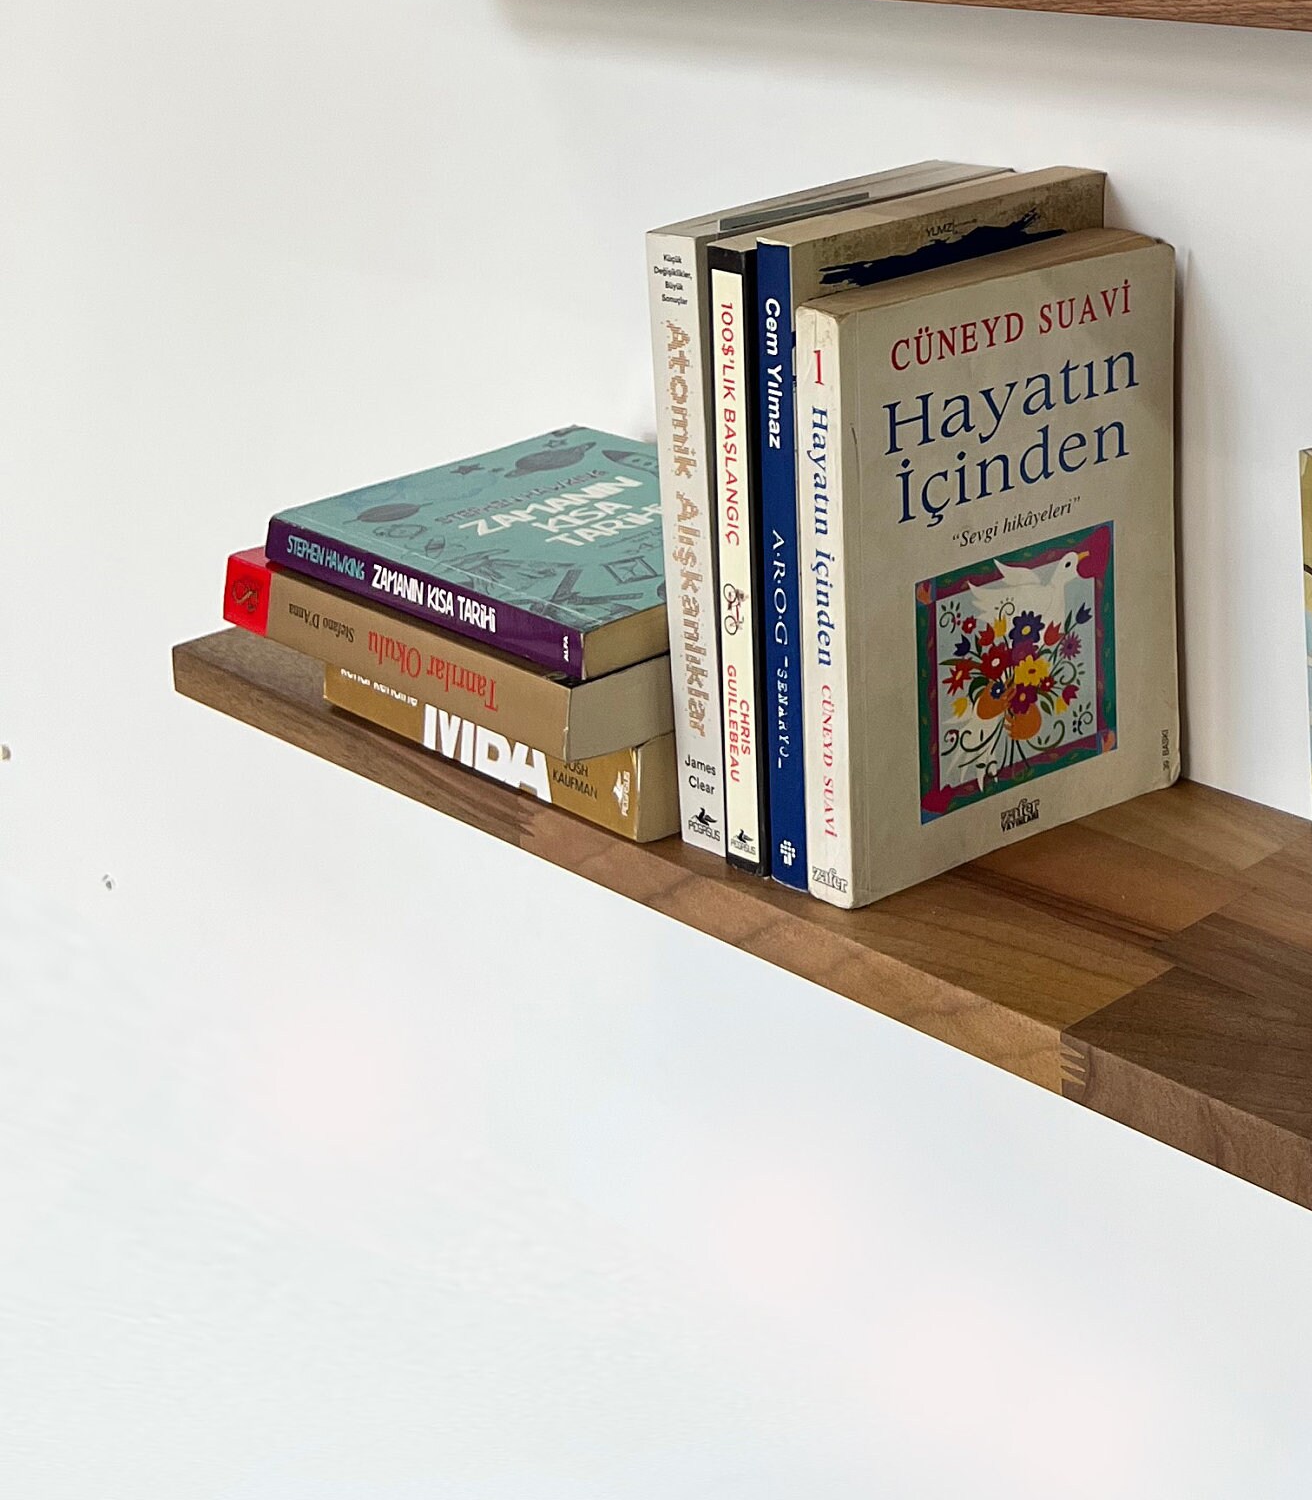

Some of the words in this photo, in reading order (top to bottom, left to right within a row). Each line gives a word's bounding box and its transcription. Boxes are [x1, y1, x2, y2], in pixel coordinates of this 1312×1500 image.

[720, 302, 736, 400] 100$'LIK
[765, 297, 781, 356] Cem
[890, 312, 1024, 371] CÜNEYD
[1038, 278, 1132, 335] SUAVİ
[812, 349, 825, 386] 1
[667, 320, 697, 480] Atomik
[766, 364, 784, 449] Yılmaz
[882, 349, 1140, 456] Hayatın
[723, 408, 740, 547] BAŞLANGIÇ
[806, 404, 829, 536] Hayatın
[895, 419, 1130, 528] İçinden
[458, 475, 644, 537] ZAMANIN
[531, 500, 633, 534] KISA
[545, 503, 662, 547] TARİH
[286, 535, 325, 565] STEPHEN
[323, 549, 366, 581] HAWKING
[371, 563, 425, 606] ZAMANIN
[427, 583, 455, 618] KISA
[457, 595, 497, 634] TARİHİ
[810, 547, 835, 667] İçinden
[288, 603, 320, 630] D'Anna
[322, 617, 356, 643] Stefano
[367, 629, 422, 679] Okulu
[425, 653, 499, 712] Tanrılar
[727, 664, 741, 783] GUILLEBEAU
[739, 700, 751, 756] CHRIS
[820, 684, 835, 768] CÜNEYD
[551, 769, 598, 800] KAUFMAN
[563, 760, 589, 778] JOSH
[684, 753, 717, 776] James
[688, 775, 715, 796] Clear
[823, 775, 839, 838] SUAVİ
[812, 866, 849, 894] zafer
